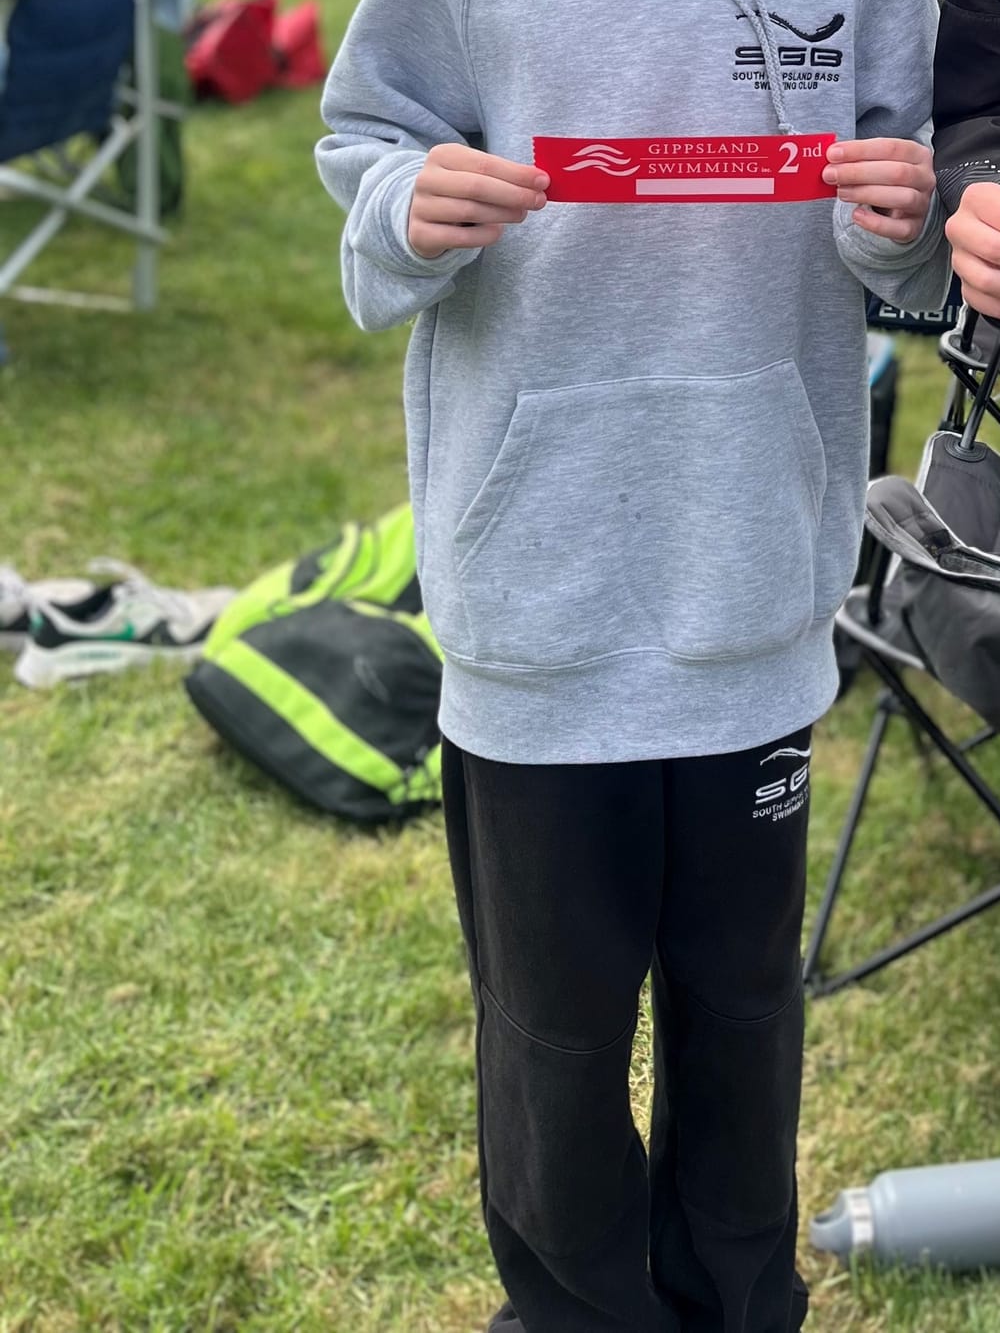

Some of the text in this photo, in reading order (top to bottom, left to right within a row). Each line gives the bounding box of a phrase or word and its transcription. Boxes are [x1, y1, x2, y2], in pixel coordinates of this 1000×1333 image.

[735, 46, 843, 67] SGB
[732, 71, 765, 81] SOUTH
[814, 72, 840, 82] BASS
[754, 81, 818, 90] SWIING CLUB
[648, 141, 823, 173] GIPPSLAND 2nd
[648, 162, 758, 174] SWIMMING
[755, 762, 808, 804] SG
[752, 802, 783, 818] SOUTH
